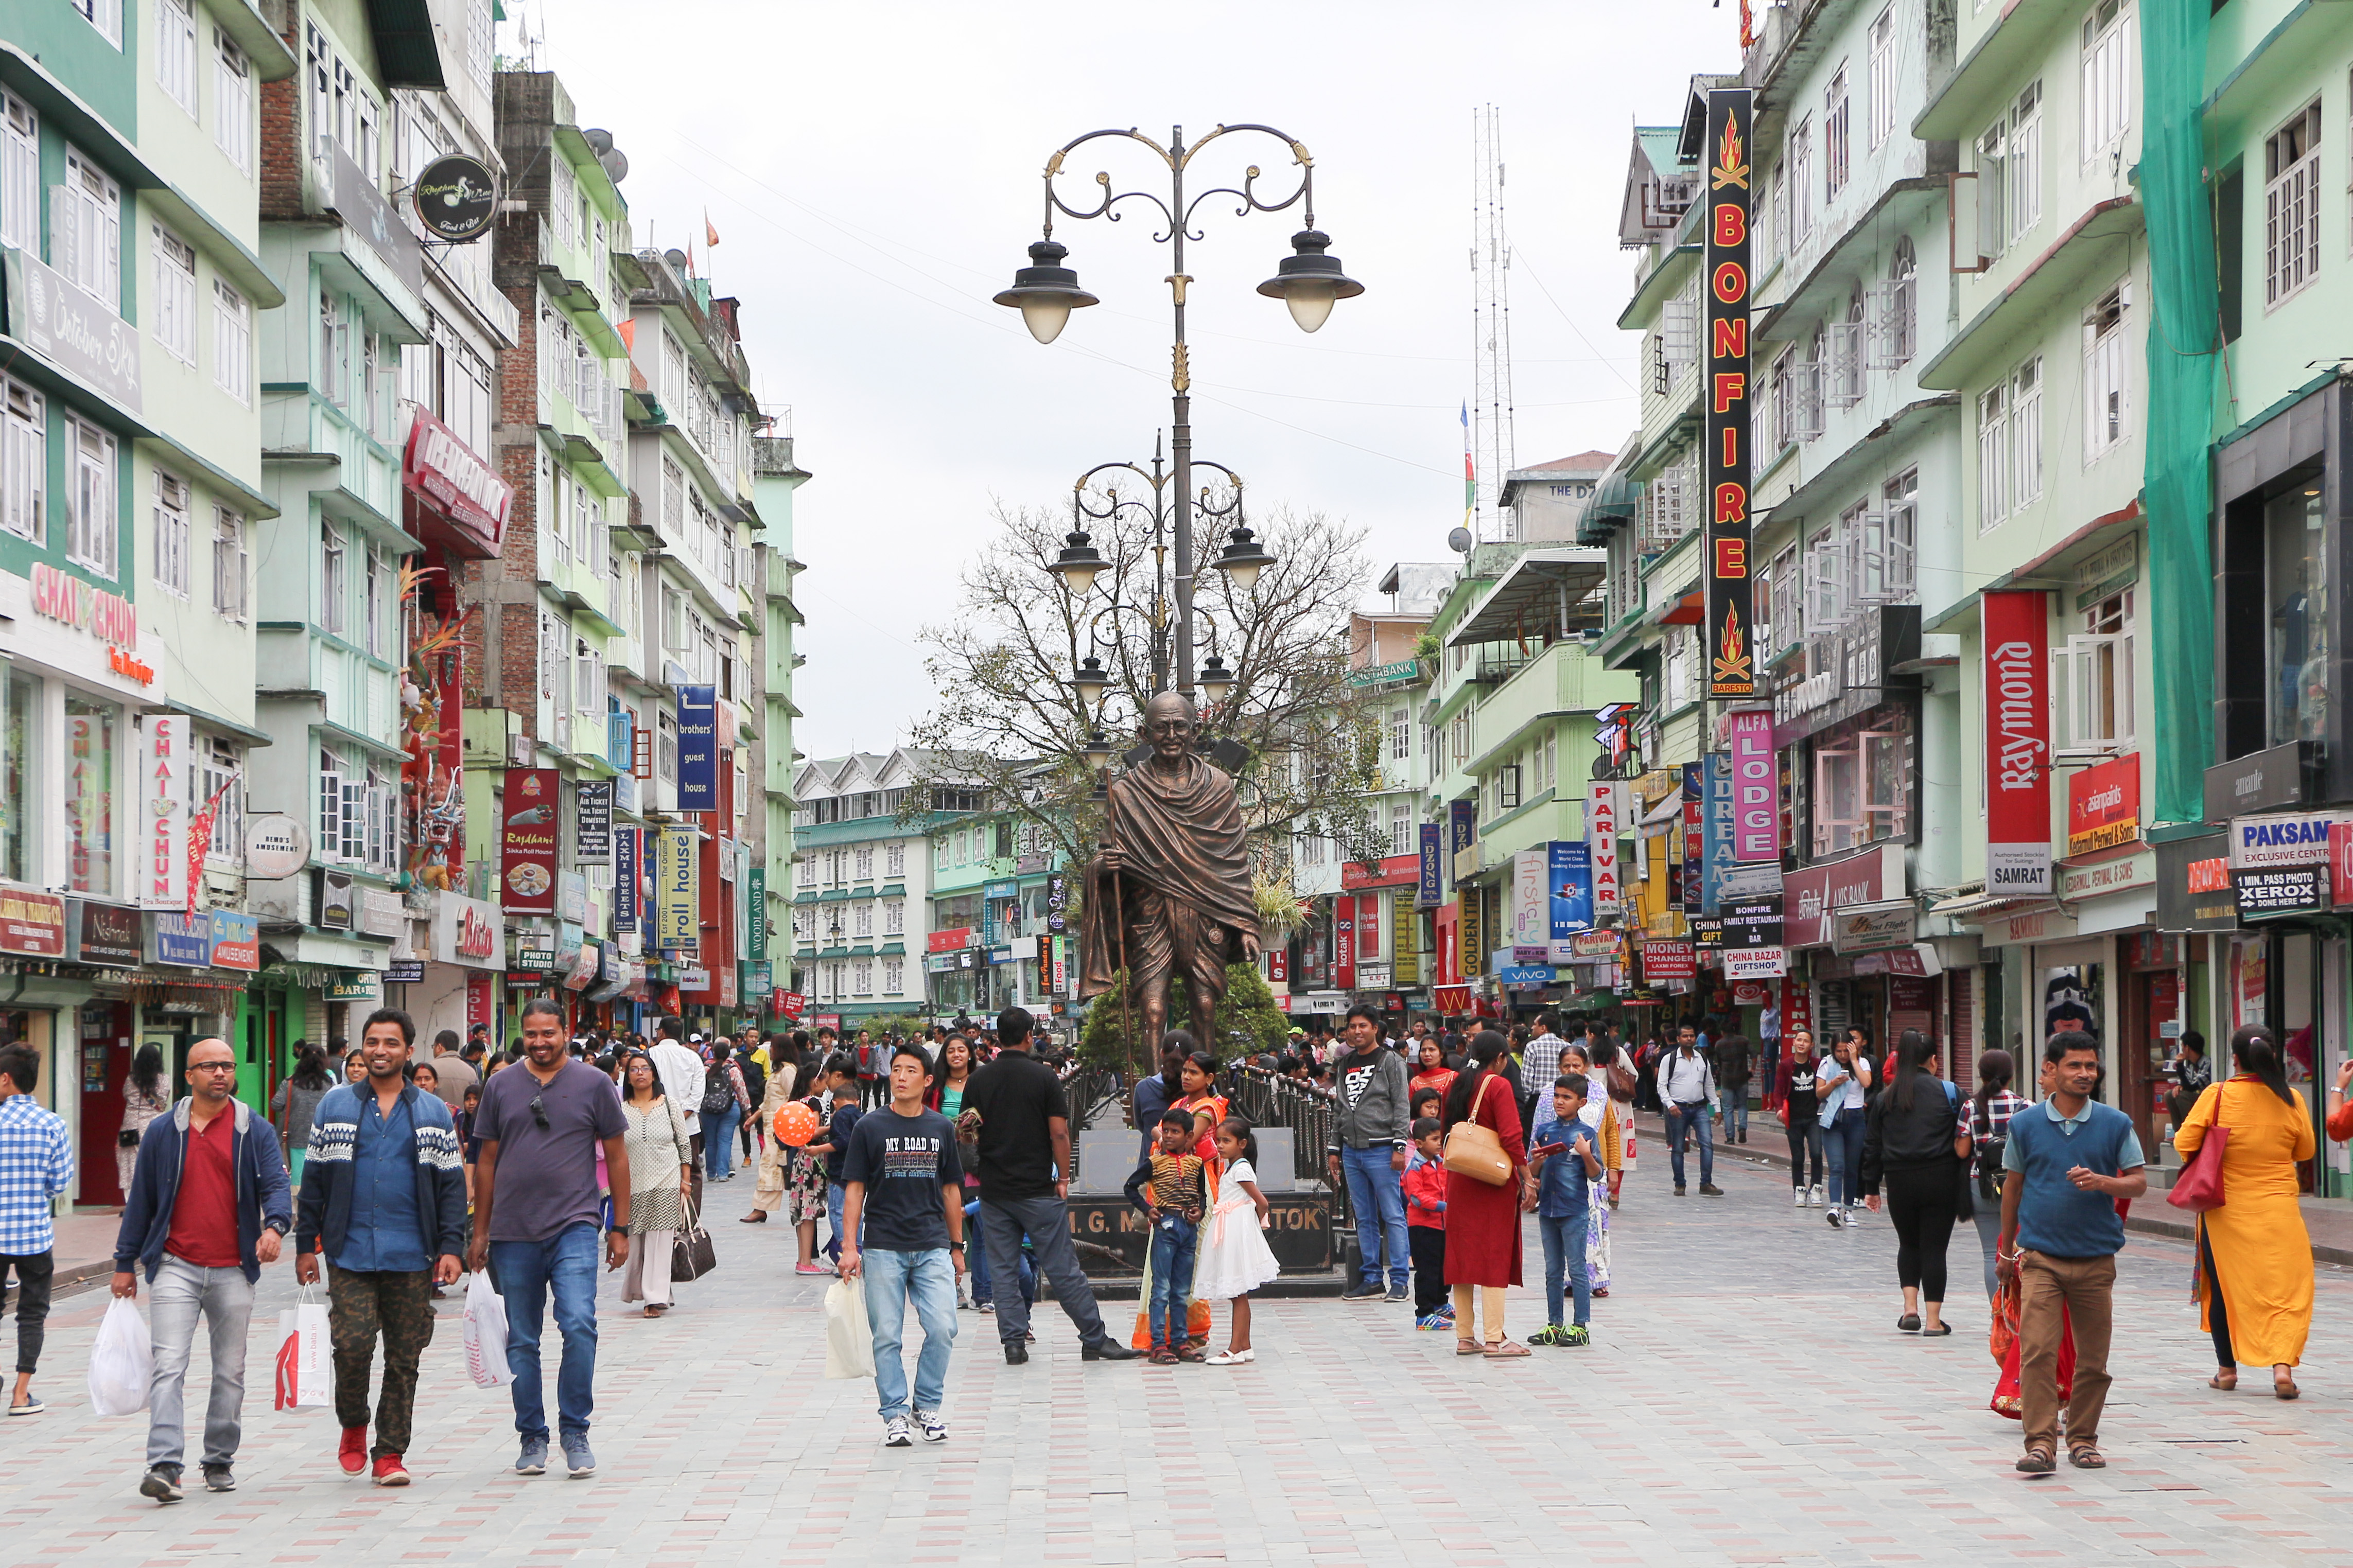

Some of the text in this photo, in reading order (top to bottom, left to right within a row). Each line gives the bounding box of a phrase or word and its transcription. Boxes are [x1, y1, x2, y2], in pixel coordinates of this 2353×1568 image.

[440, 220, 458, 231] Food
[466, 217, 479, 229] Bar
[65, 195, 76, 281] HOTEL
[54, 280, 101, 365] October
[106, 322, 138, 393] Sky
[1713, 203, 1748, 579] BONFIRE
[447, 441, 488, 508] DRAGON
[425, 475, 446, 501] AUTHENTIC
[30, 561, 136, 651] CHAI CHUN
[1713, 684, 1752, 693] BARESTO
[1737, 715, 1769, 732] ALFA
[1991, 641, 2045, 791] Raymond
[679, 723, 712, 735] brothers'
[155, 719, 172, 797] CHAI
[685, 753, 705, 763] guest
[685, 782, 706, 793] house
[2236, 769, 2263, 796] amante
[1741, 737, 1773, 852] LODGE
[507, 832, 554, 846] Rajdhani
[2069, 823, 2133, 855] Kedarmull Periwal & Sons
[2243, 820, 2332, 847] PAKSAM
[256, 844, 298, 852] AMUSEMENT
[620, 832, 630, 870] LAXMI
[1595, 788, 1616, 901] PARIVAR
[155, 819, 170, 895] CHUN
[1425, 846, 1435, 888] DZONG
[2245, 851, 2295, 862] EXCLUSIVE
[672, 835, 689, 936] roll house
[1995, 868, 2045, 884] SAMRAT
[2065, 861, 2133, 893] KEDARMULL PERIWAL & SONS
[2238, 872, 2313, 887] 1 MIN. PASS PHOTO
[620, 874, 631, 917] SWEETS
[1849, 880, 1869, 904] BANK
[2239, 884, 2314, 900] XEROX
[2258, 897, 2297, 907] DONE HERE
[1724, 915, 1784, 925] FAMILY RESTAURANT
[1736, 906, 1771, 914] BONFIRE
[753, 891, 762, 952] WOODLAND
[1465, 888, 1477, 976] GOLDEN TIPS
[1695, 921, 1721, 930] CHINA
[1884, 920, 1908, 929] Flight
[2010, 913, 2045, 940] SAMRAT
[1579, 934, 1615, 945] PARIVAR
[1702, 932, 1721, 941] GIFT
[1749, 935, 1762, 943] BAR
[108, 947, 117, 955] BABY
[217, 945, 254, 963] AMUSEMENT
[524, 952, 552, 960] PHOTO
[1054, 935, 1062, 960] Court
[1338, 936, 1348, 967] kotak
[1647, 943, 1693, 954] MONEY
[1728, 950, 1782, 962] CHINA BAZAR
[521, 960, 552, 968] STUDIO
[1040, 945, 1049, 974] Panda's
[1734, 961, 1777, 971] GIFTSHOP
[1054, 962, 1062, 983] Food
[1512, 970, 1546, 980] vivo
[334, 985, 361, 995] BAR
[468, 989, 481, 1019] ROLL
[1442, 990, 1467, 1014] W
[885, 1137, 939, 1152] MY ROAD TO
[884, 1151, 938, 1173] SUCCESS
[1088, 1211, 1110, 1232] G.
